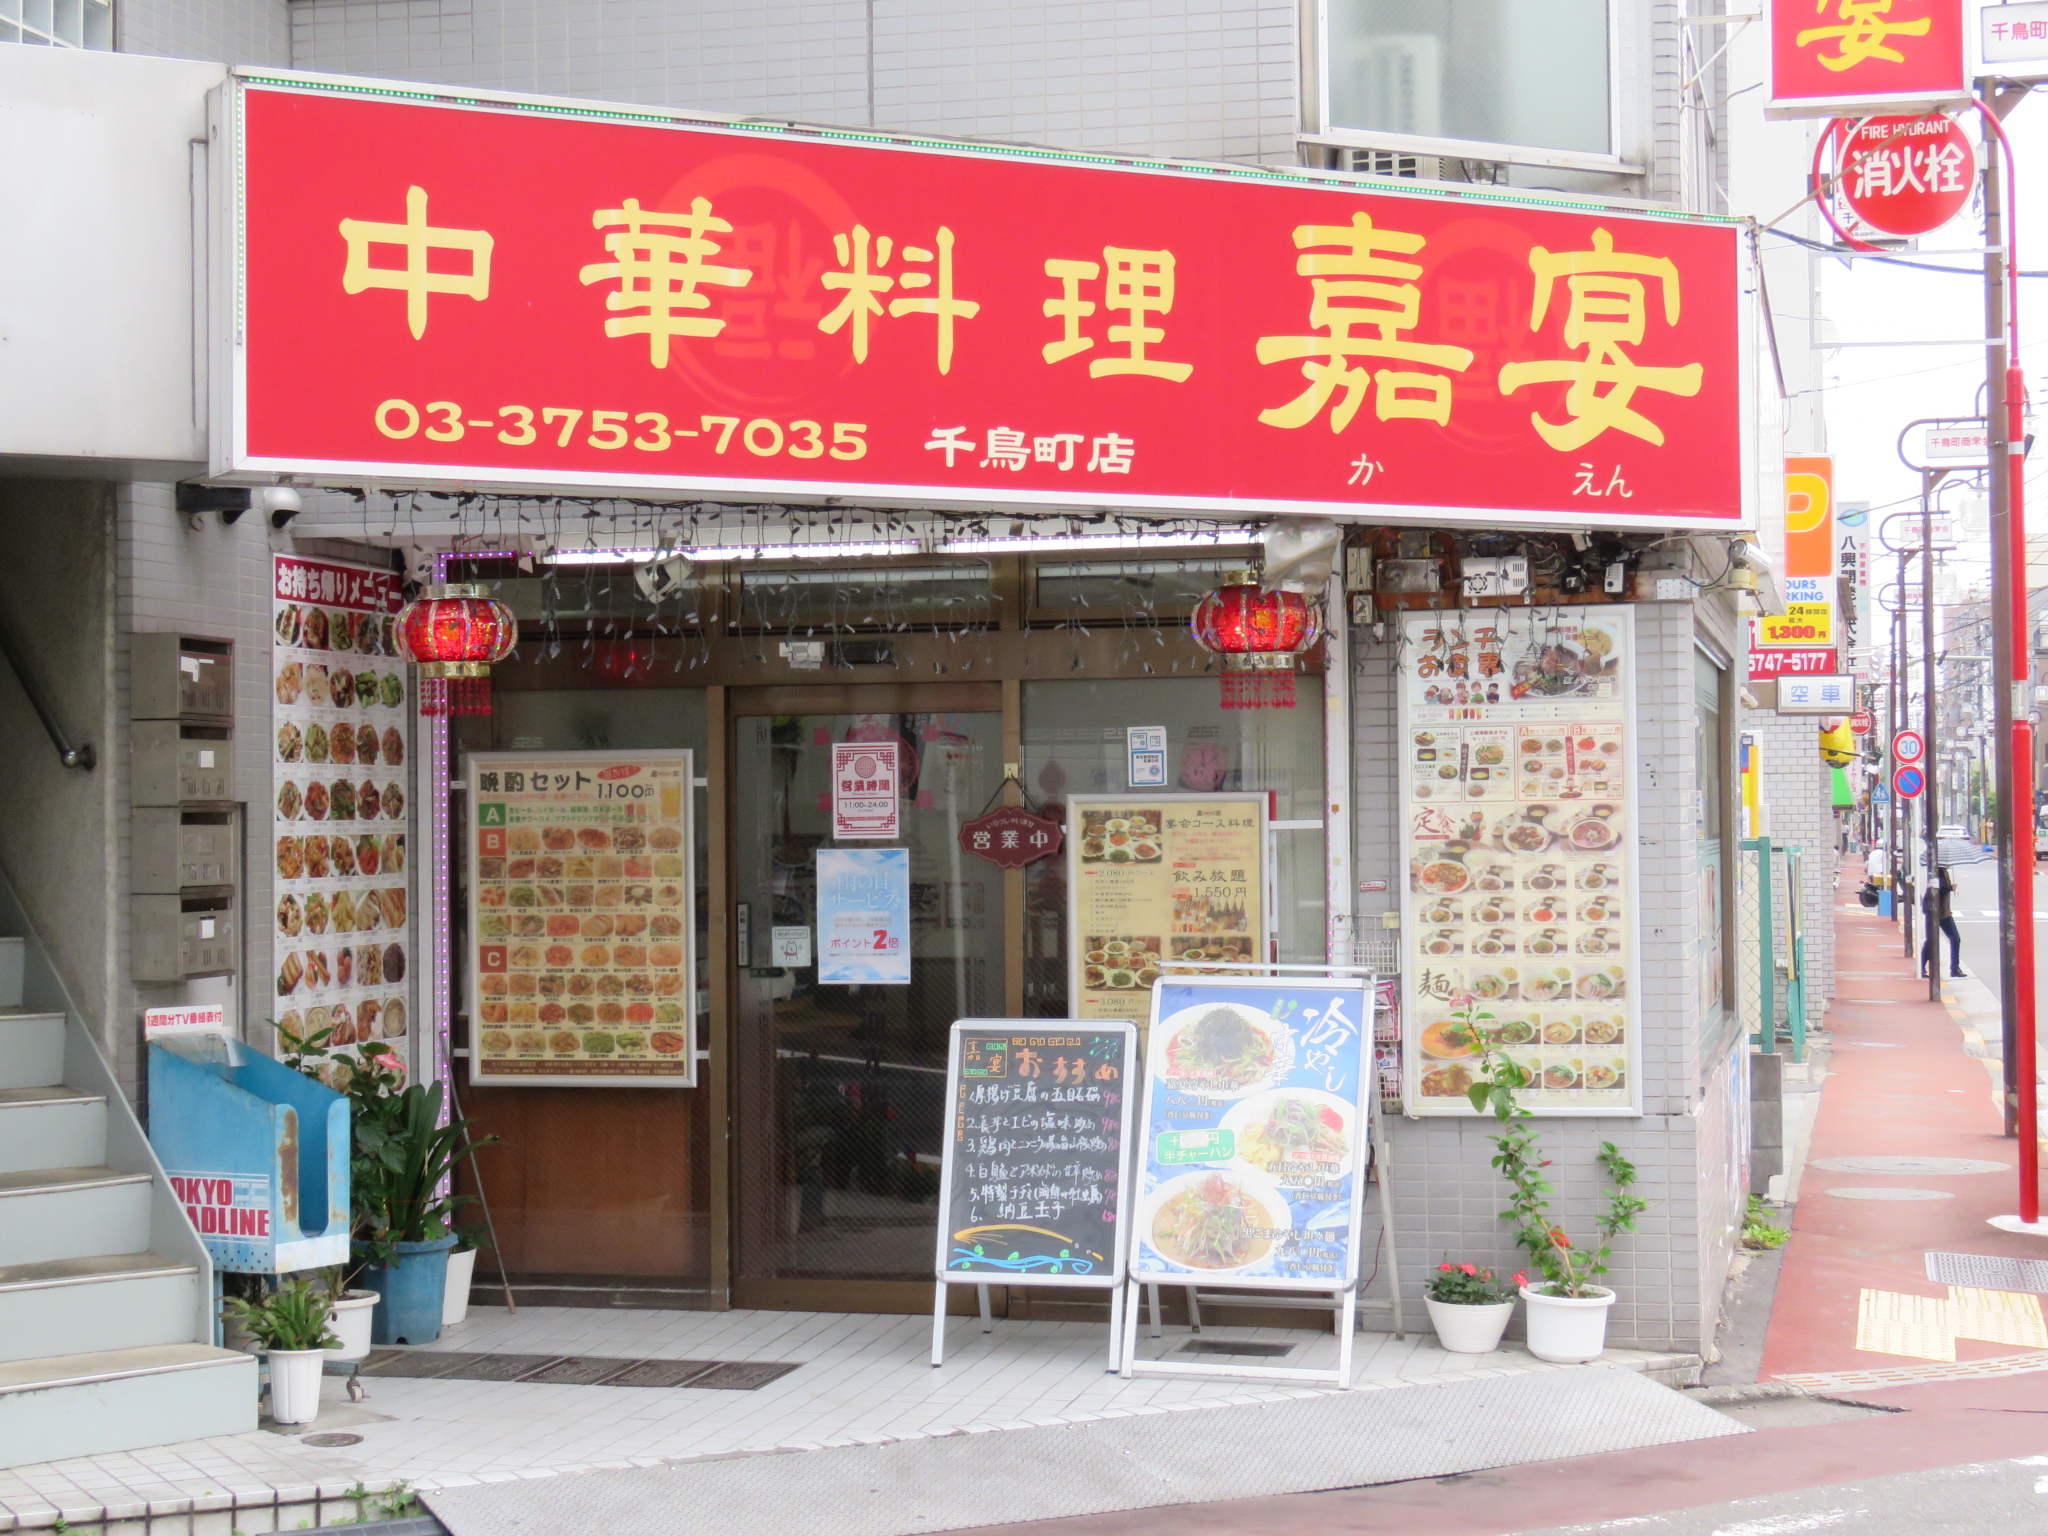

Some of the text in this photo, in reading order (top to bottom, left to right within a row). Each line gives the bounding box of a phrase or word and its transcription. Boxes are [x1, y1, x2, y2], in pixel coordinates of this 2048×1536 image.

[1861, 119, 1950, 140] FIRE HYDRANT
[1852, 142, 1965, 199] 消火栓
[339, 185, 1704, 453] 中華料理 嘉宴
[374, 398, 868, 462] 03-3753-7035
[925, 426, 1135, 475] 千鳥町店
[1348, 455, 1633, 499] か えん
[278, 562, 403, 608] お持ち帰りメニュー
[1422, 627, 1499, 650] ランチ
[1417, 652, 1503, 679] お食事
[1790, 684, 1841, 704] 空車
[1900, 740, 1918, 755] 30
[479, 770, 592, 793] 晩酌セット
[841, 779, 891, 792] 営業時間
[486, 806, 500, 822] A
[1164, 818, 1256, 829] 宴会コース料理
[1413, 806, 1456, 835] 定食
[487, 833, 500, 849] B
[972, 829, 1049, 850] 営業中
[837, 871, 889, 892] 雨の日
[1172, 869, 1248, 883] 飲み放題
[487, 950, 501, 967] C
[1418, 967, 1451, 1002] 麺
[1300, 997, 1358, 1092] 冷やし
[1015, 1047, 1119, 1086] おすすめ
[1164, 1147, 1233, 1163] 半チャーハン
[170, 1177, 233, 1206] OKYO
